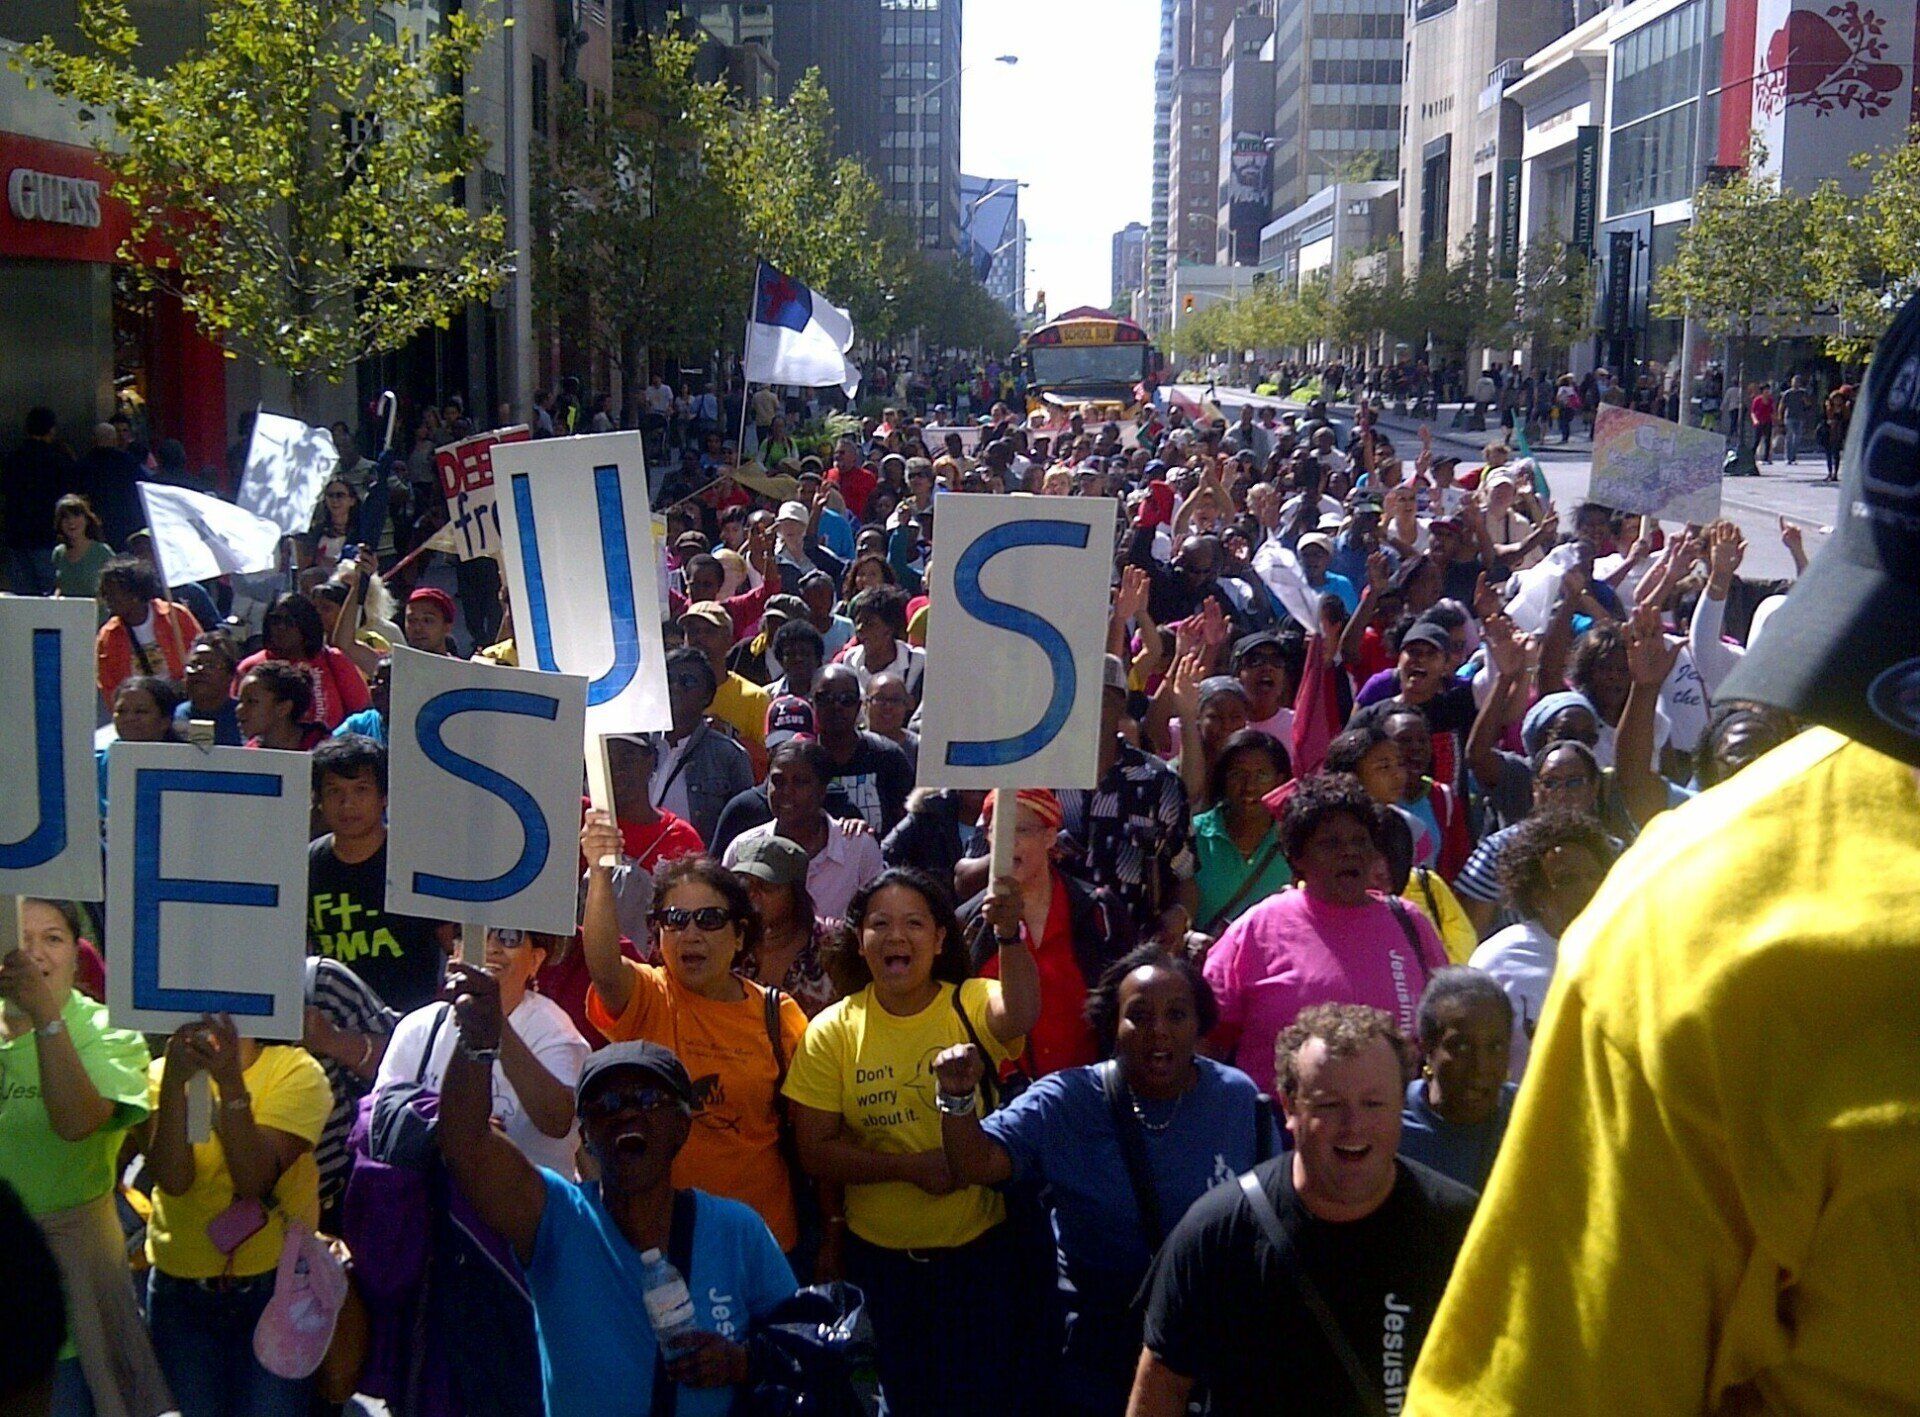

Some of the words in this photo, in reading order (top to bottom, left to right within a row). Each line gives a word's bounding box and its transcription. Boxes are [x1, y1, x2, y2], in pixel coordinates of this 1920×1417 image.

[8, 168, 101, 228] GUESS
[511, 464, 641, 707] U
[945, 519, 1091, 767] S
[412, 687, 560, 903] S
[134, 768, 283, 1017] E
[855, 1064, 894, 1084] Don't
[857, 1089, 898, 1107] worry
[861, 1110, 903, 1127] about
[904, 1107, 920, 1122] it.
[708, 1286, 735, 1341] Jes
